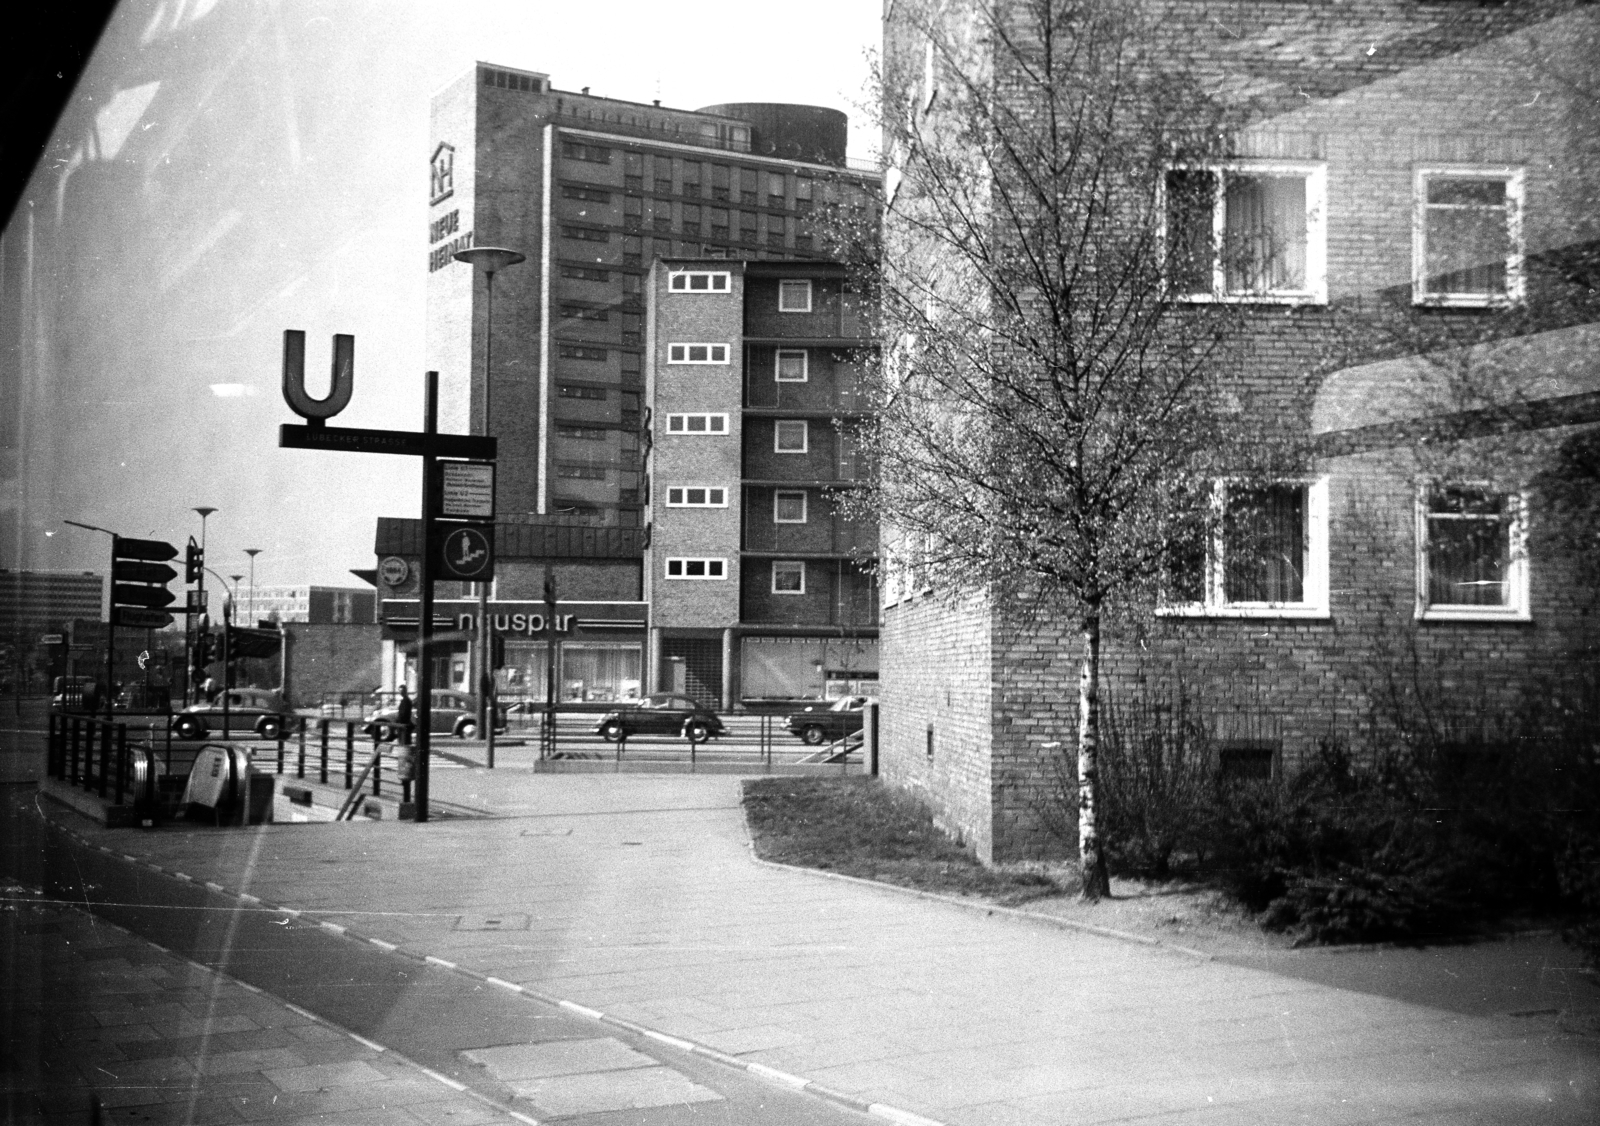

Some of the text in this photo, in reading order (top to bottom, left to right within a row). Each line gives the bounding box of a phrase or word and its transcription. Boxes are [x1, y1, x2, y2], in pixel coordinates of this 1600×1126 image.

[428, 208, 460, 245] NEUE
[428, 230, 473, 274] HEIMAT
[281, 328, 356, 419] U
[362, 436, 408, 446] STRASSE
